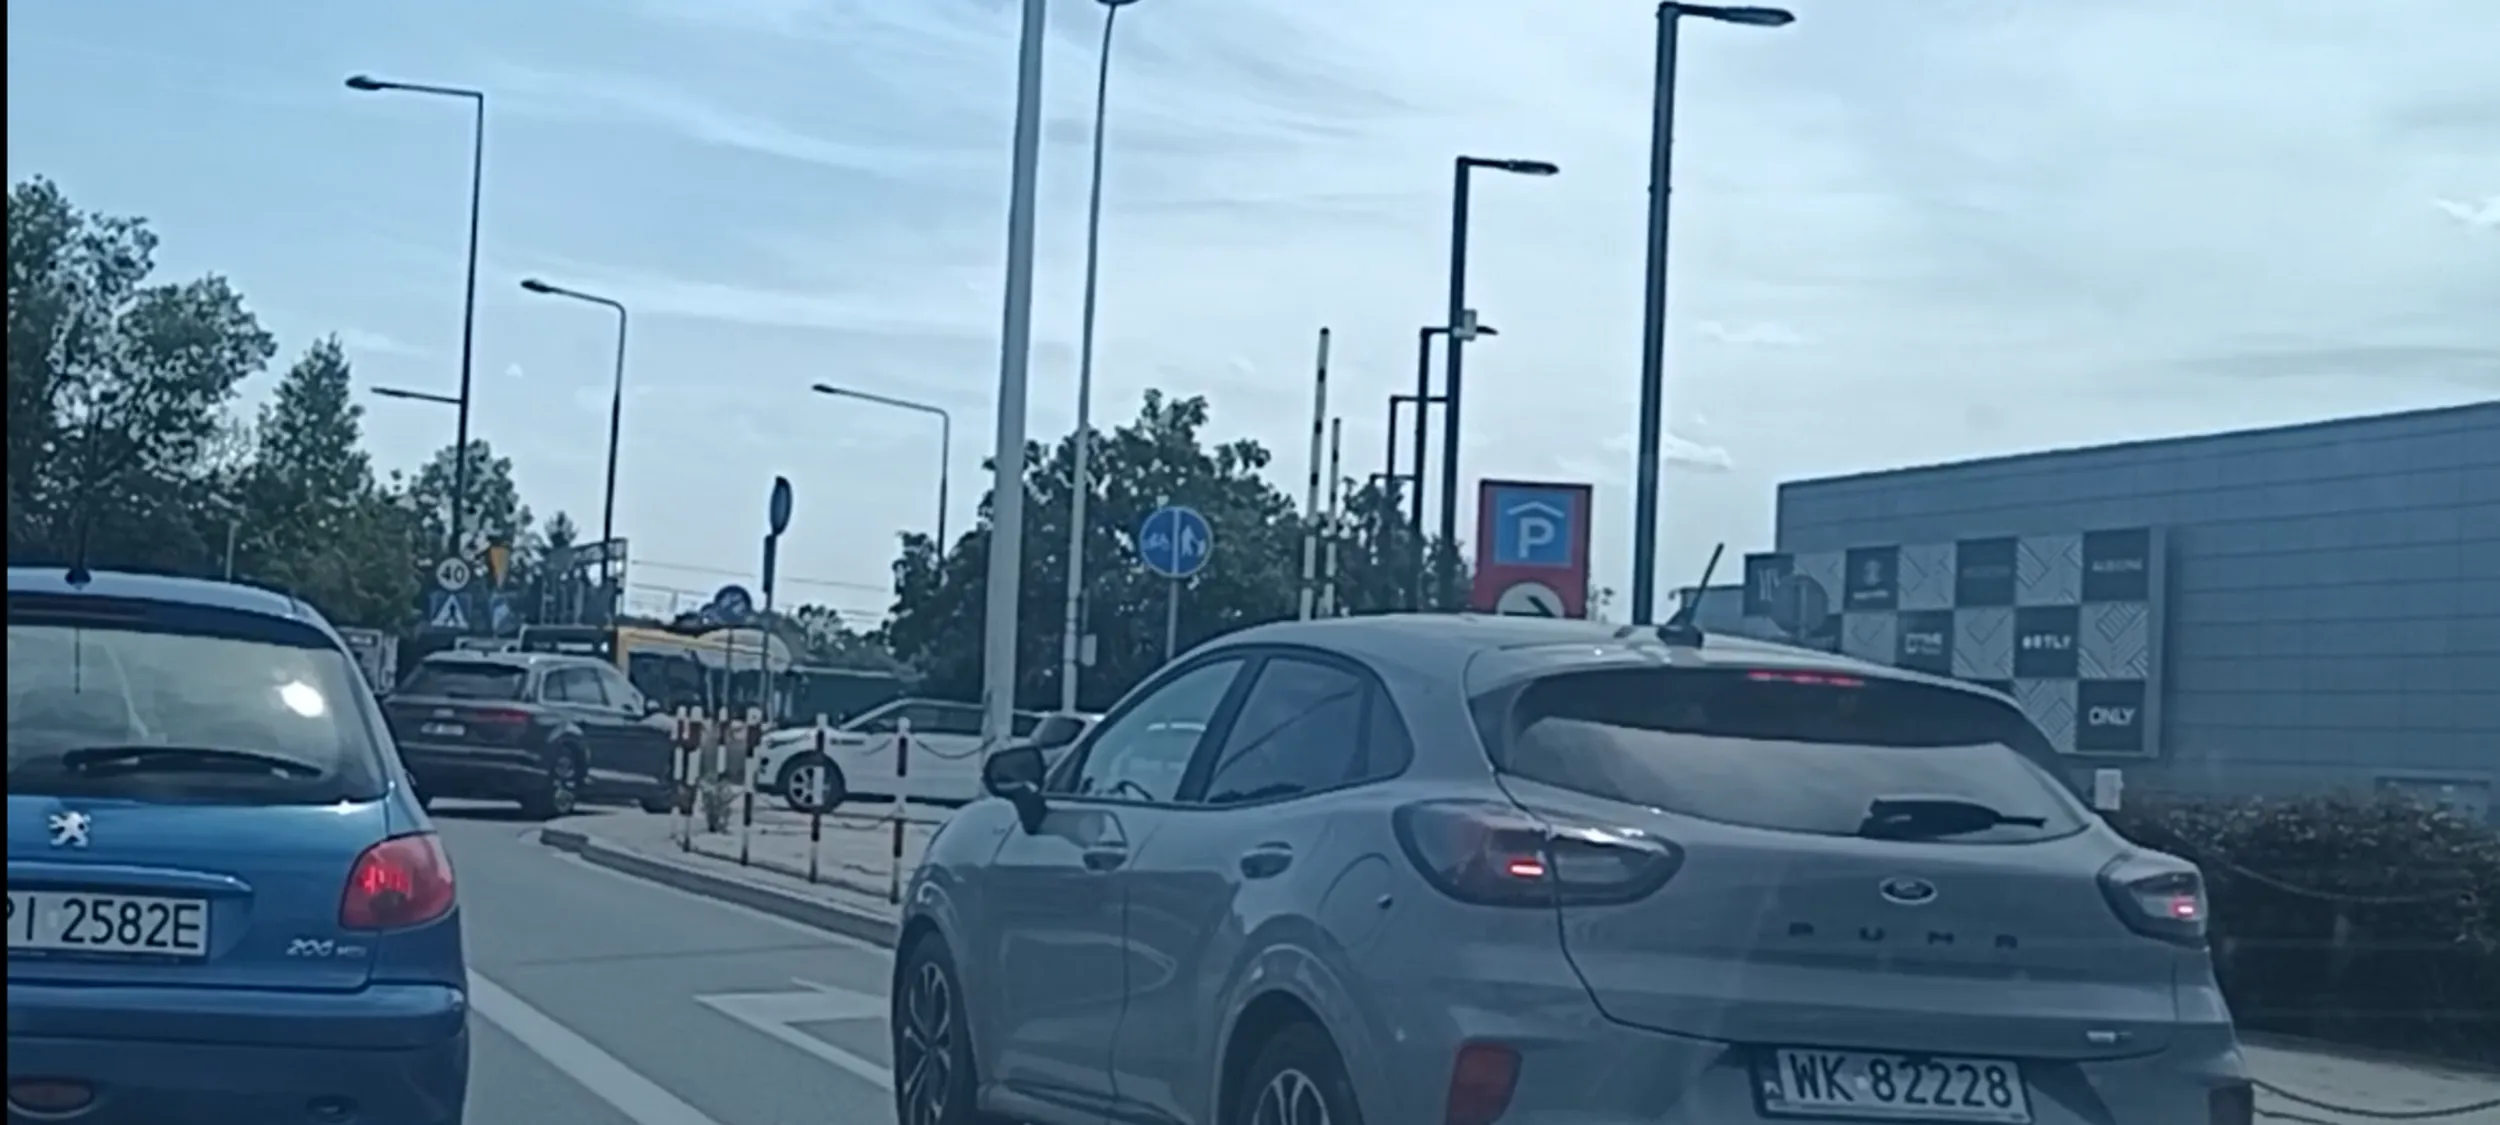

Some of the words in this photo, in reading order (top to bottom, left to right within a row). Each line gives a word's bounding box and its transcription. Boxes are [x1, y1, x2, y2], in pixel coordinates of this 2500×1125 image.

[1519, 517, 1555, 558] P
[440, 565, 464, 583] 40
[2088, 706, 2136, 726] ONLY
[61, 898, 201, 949] 2582E
[286, 938, 334, 957] 206
[1789, 1052, 1854, 1101] WK
[1868, 1058, 2012, 1108] 82228
